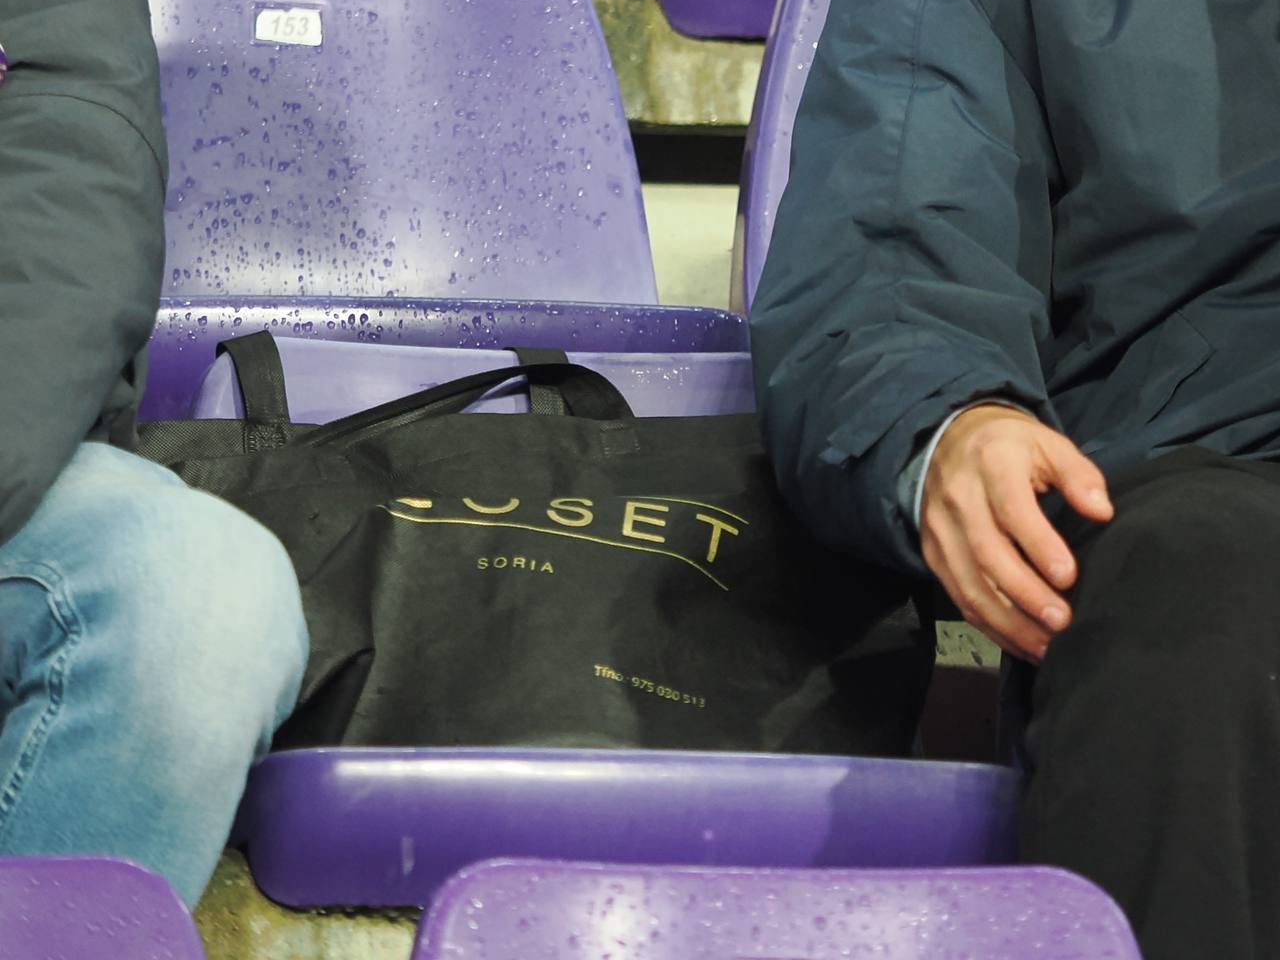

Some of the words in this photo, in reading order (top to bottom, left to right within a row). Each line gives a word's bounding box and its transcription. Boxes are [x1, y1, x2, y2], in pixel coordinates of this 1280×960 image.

[271, 15, 310, 37] 153
[477, 556, 554, 574] SORIA
[631, 676, 654, 693] 975
